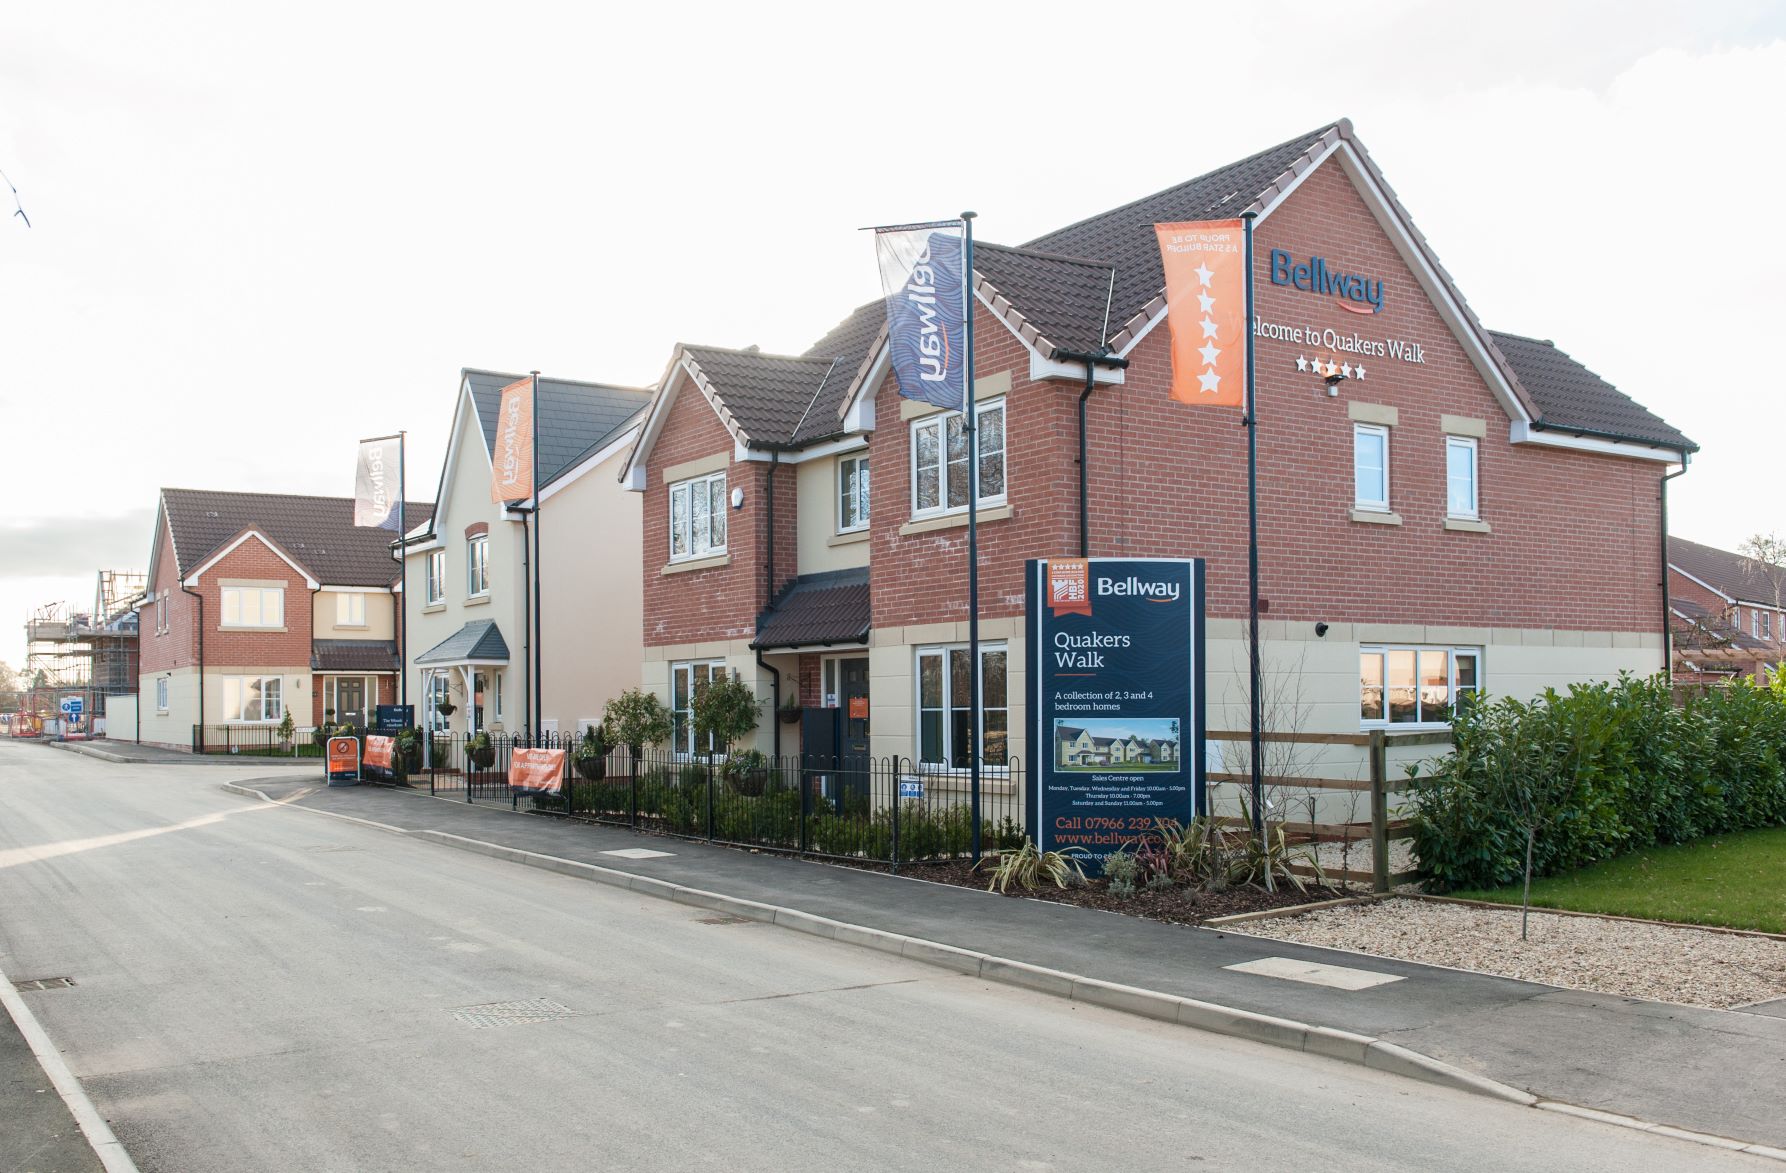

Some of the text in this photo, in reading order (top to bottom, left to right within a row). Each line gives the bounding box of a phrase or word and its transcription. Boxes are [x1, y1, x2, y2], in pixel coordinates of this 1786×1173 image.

[1271, 248, 1384, 314] Bellway
[1251, 315, 1425, 364] lcome to Quakers Walk
[1097, 576, 1180, 600] Bellway
[1054, 631, 1131, 650] Quakers
[1054, 651, 1105, 668] Walk
[1054, 691, 1154, 701] A collection of 2, 3 and 4
[1054, 702, 1121, 711] bedroom homes
[1091, 785, 1120, 793] Wednesday
[1130, 785, 1146, 793] Friday
[1055, 816, 1082, 829] Call
[1084, 816, 1125, 830] 07966
[1127, 816, 1151, 830] 239
